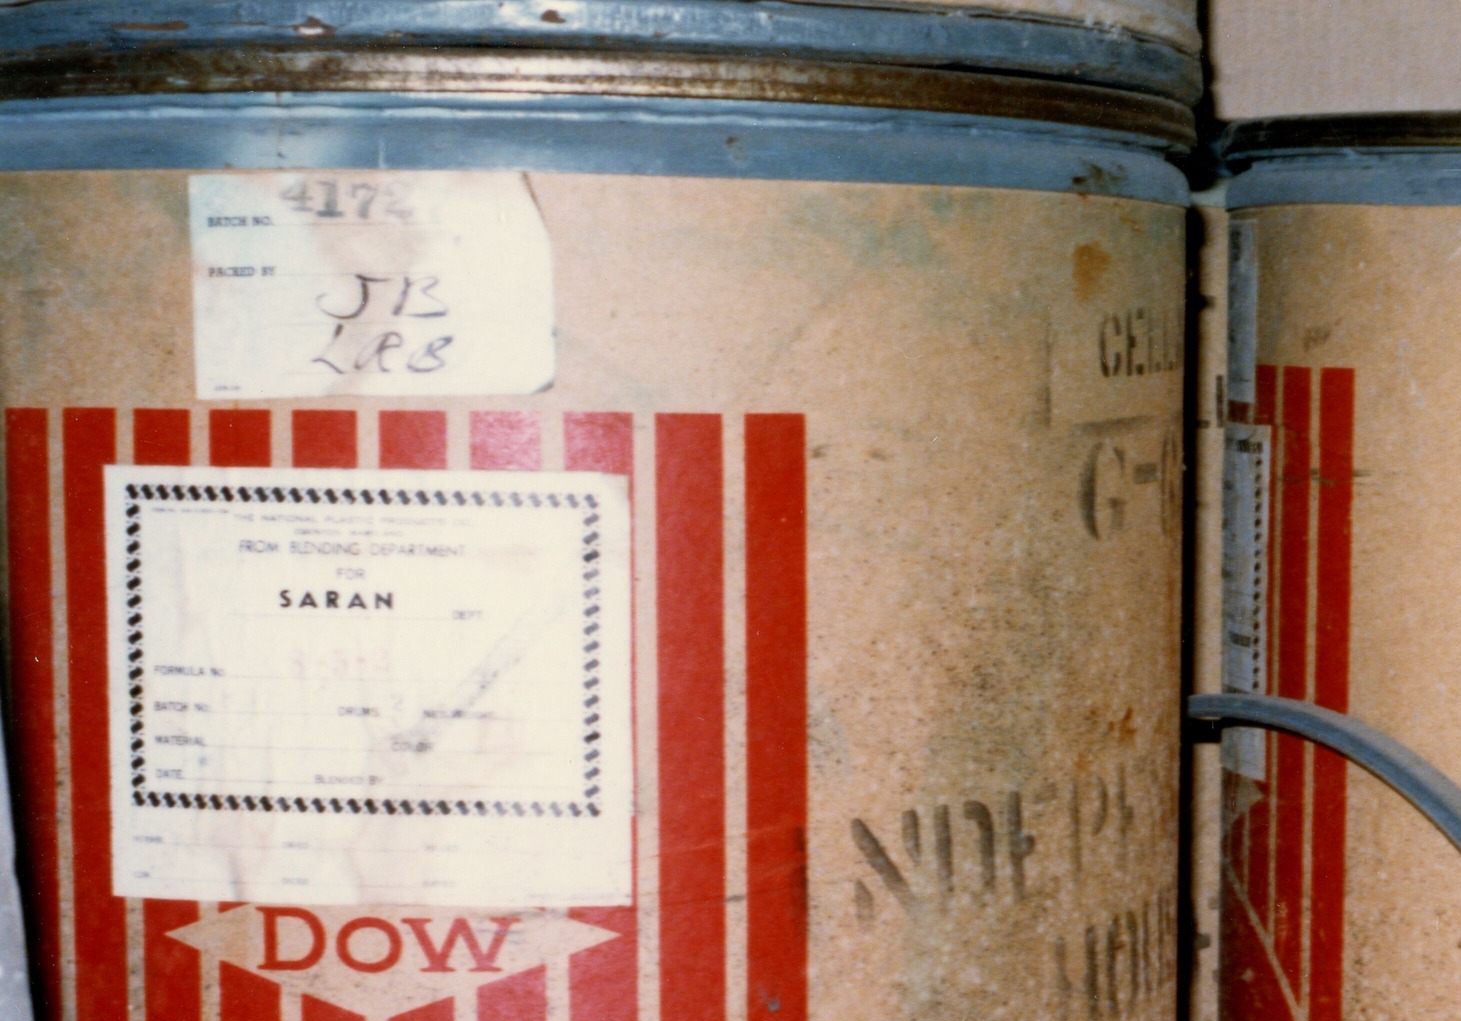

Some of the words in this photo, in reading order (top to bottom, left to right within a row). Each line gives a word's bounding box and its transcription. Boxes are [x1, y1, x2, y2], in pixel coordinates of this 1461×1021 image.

[238, 539, 279, 553] FROM
[289, 540, 362, 556] BLENDING
[370, 542, 466, 557] DEPARTMENT
[336, 567, 367, 580] FOR
[279, 589, 394, 609] SARAN
[154, 664, 205, 677] FORMULA
[155, 768, 184, 779] DATE
